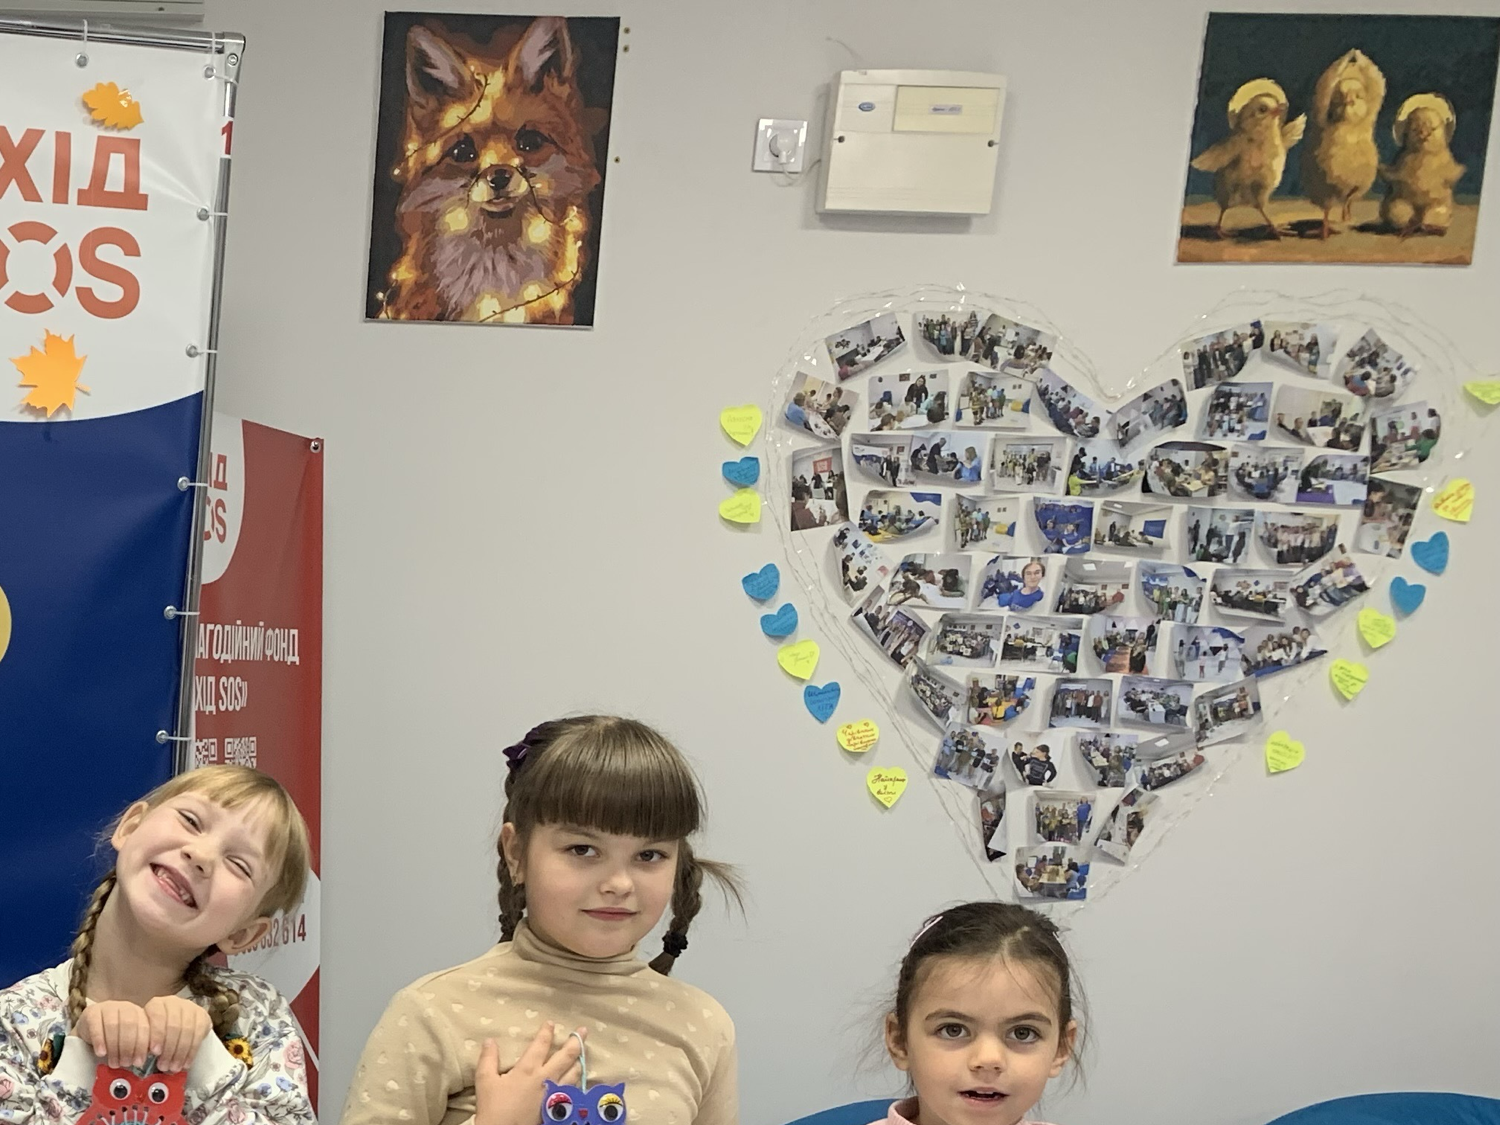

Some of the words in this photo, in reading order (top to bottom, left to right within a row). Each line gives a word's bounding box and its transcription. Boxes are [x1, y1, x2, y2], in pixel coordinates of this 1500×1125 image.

[196, 619, 264, 664] АГОДІЙНИЙ
[264, 627, 300, 666] ФОНД
[194, 675, 217, 715] ХІД
